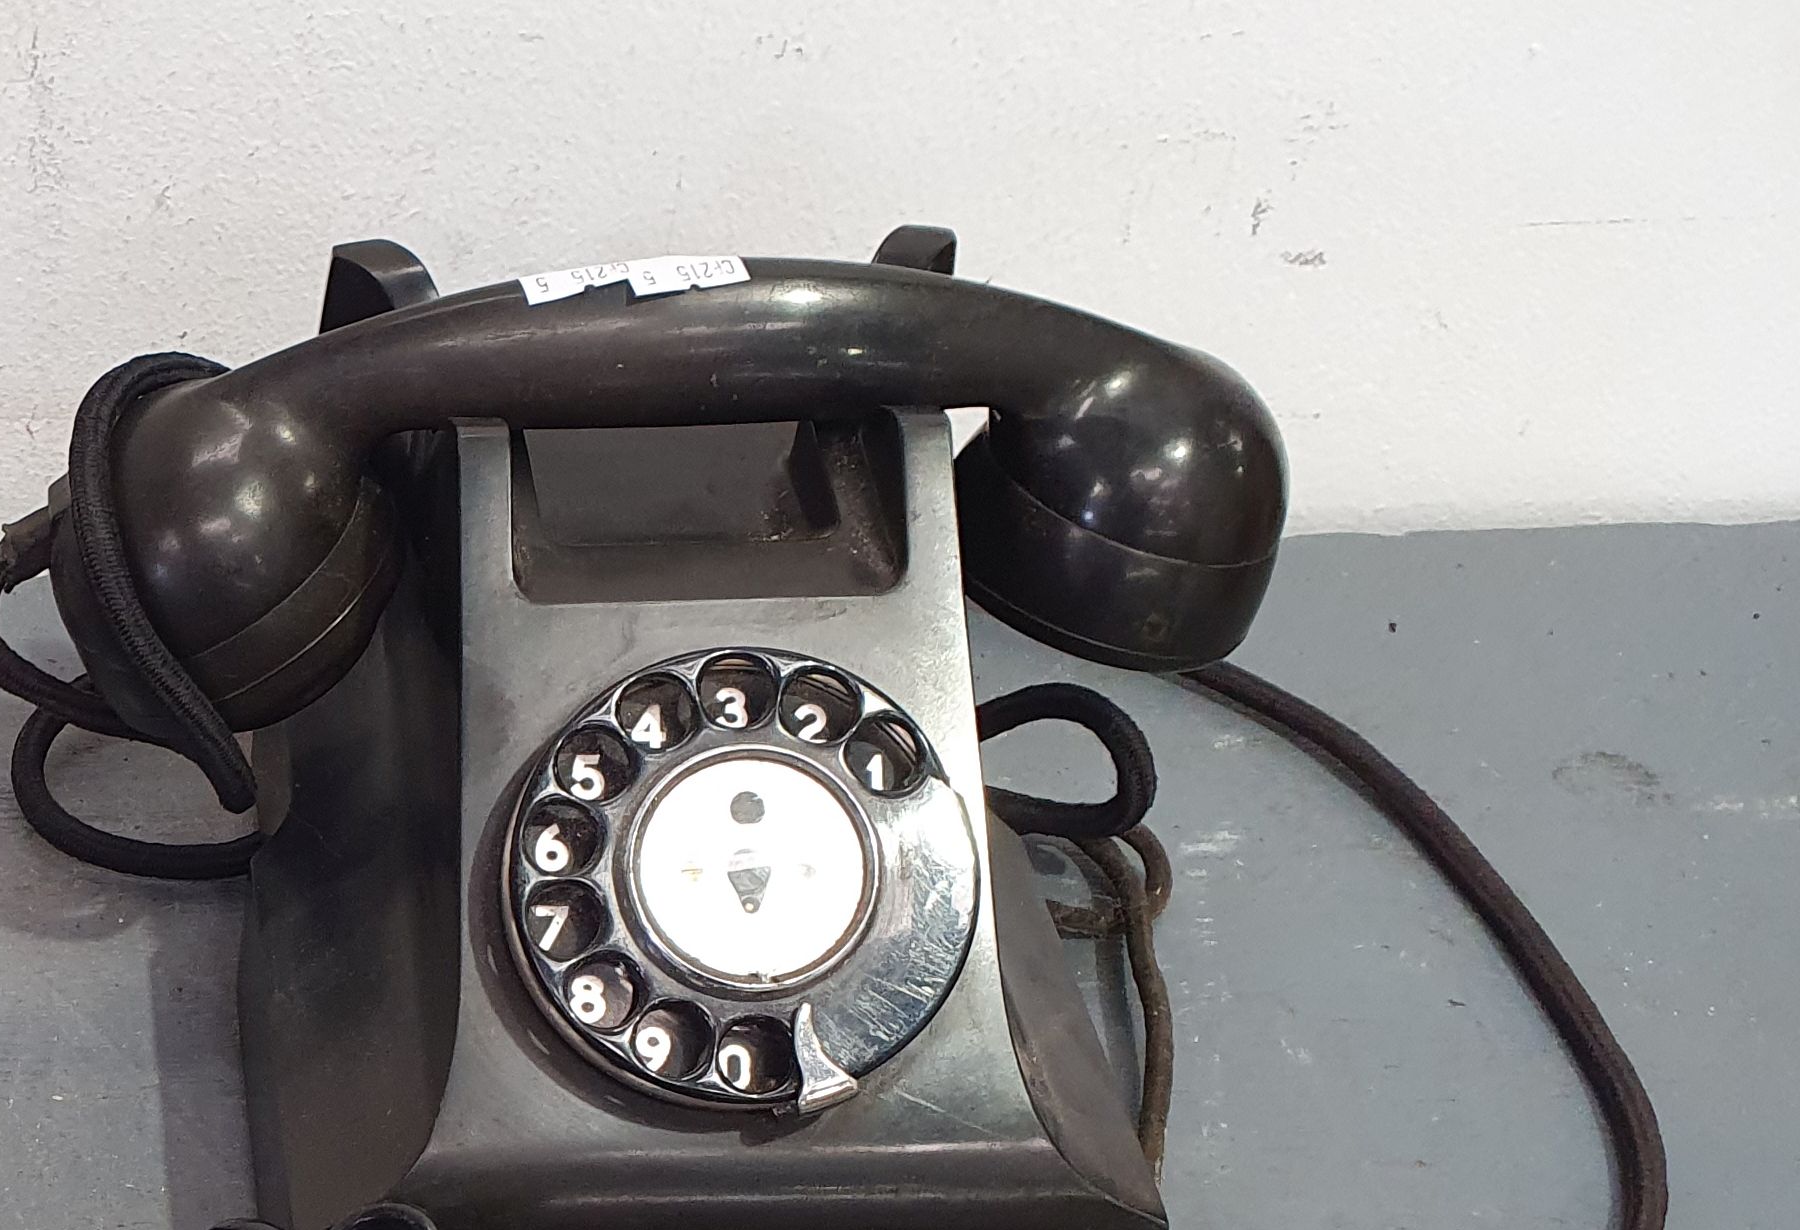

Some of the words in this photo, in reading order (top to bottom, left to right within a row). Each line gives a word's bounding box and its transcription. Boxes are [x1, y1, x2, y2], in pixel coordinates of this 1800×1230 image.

[535, 276, 550, 294] 5
[642, 270, 657, 286] 5
[631, 703, 668, 749] 4
[715, 687, 748, 729] 3
[794, 703, 828, 743] 2
[570, 754, 606, 800] 5
[864, 753, 886, 791] 1
[534, 823, 570, 872] 6
[530, 904, 569, 952] 7
[569, 974, 606, 1024] 8
[634, 1025, 671, 1073] 9
[717, 1043, 752, 1090] 0
